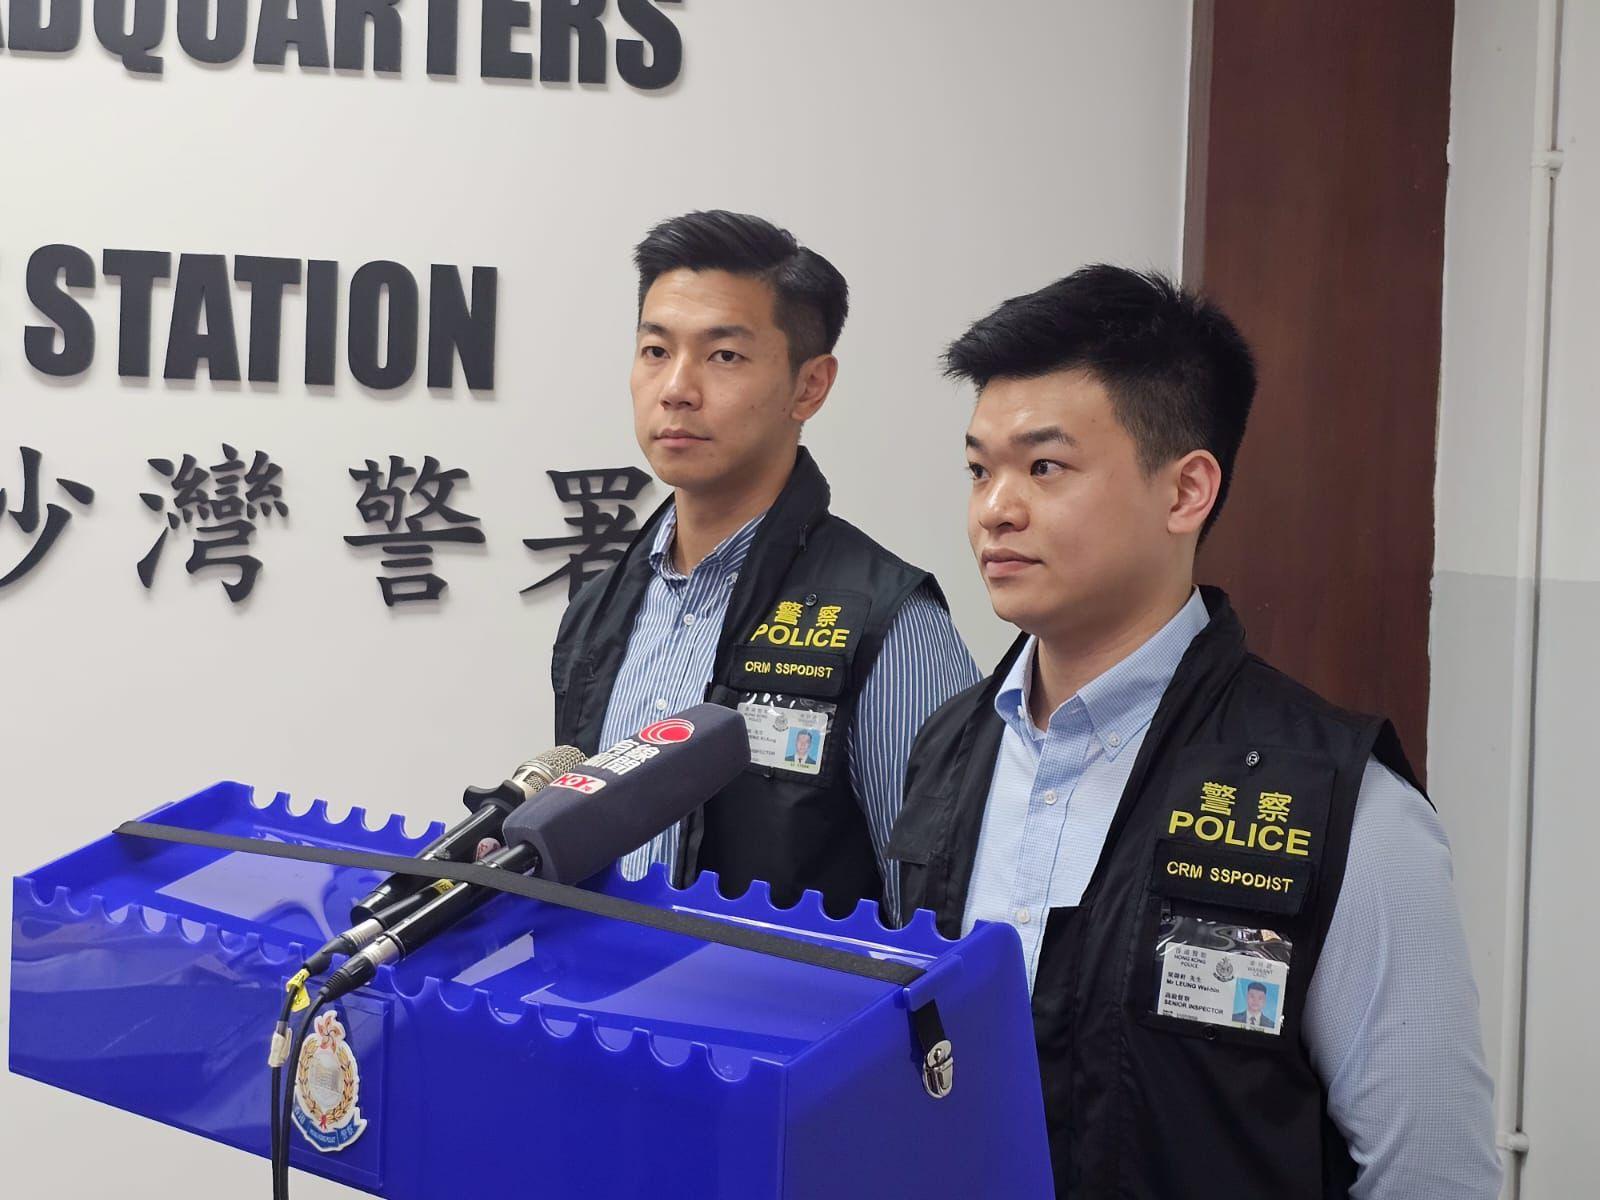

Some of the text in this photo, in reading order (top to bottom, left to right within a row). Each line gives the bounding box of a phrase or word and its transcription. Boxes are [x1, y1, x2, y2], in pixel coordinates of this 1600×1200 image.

[0, 0, 683, 90] QUARTERS
[24, 243, 497, 391] STATION
[750, 623, 850, 648] POLICE
[745, 661, 834, 679] CRM SSPODIST
[1200, 781, 1293, 823] 警察
[1168, 810, 1312, 856] POLICE
[1166, 860, 1294, 893] CRM SSPODIST
[1175, 981, 1197, 989] LEUNG
[1164, 999, 1224, 1015] SENIOR INSPECTOR
